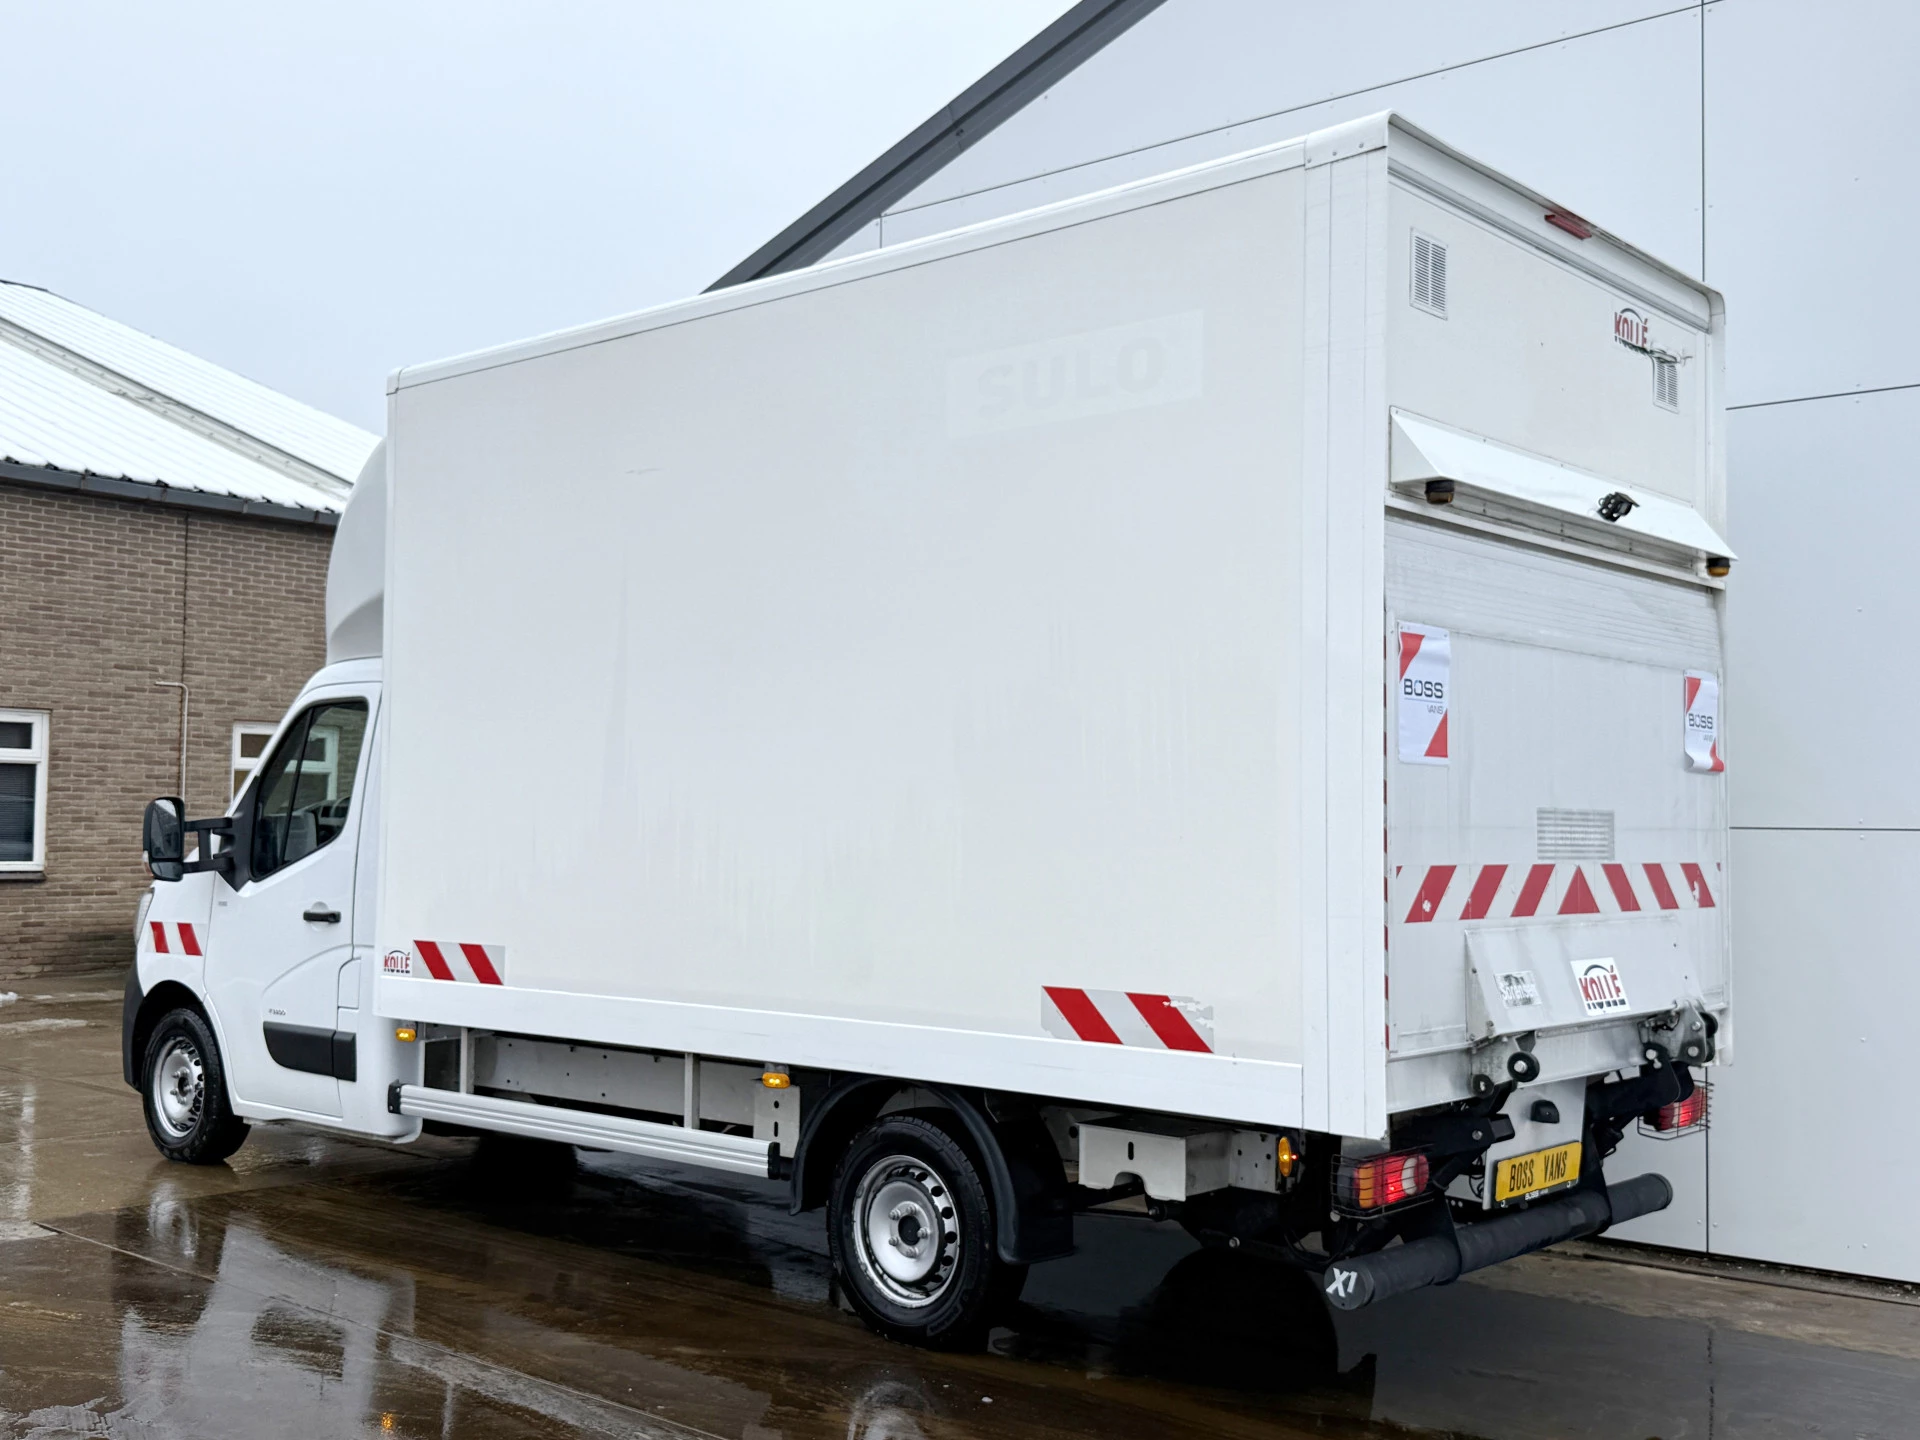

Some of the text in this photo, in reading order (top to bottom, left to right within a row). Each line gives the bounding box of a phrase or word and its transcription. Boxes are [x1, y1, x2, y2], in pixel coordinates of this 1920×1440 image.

[977, 337, 1165, 419] SULO
[1404, 678, 1443, 699] BOSS
[1689, 713, 1713, 730] BOSS
[1509, 1150, 1568, 1193] BOSS VANS
[1325, 1267, 1358, 1298] X1
